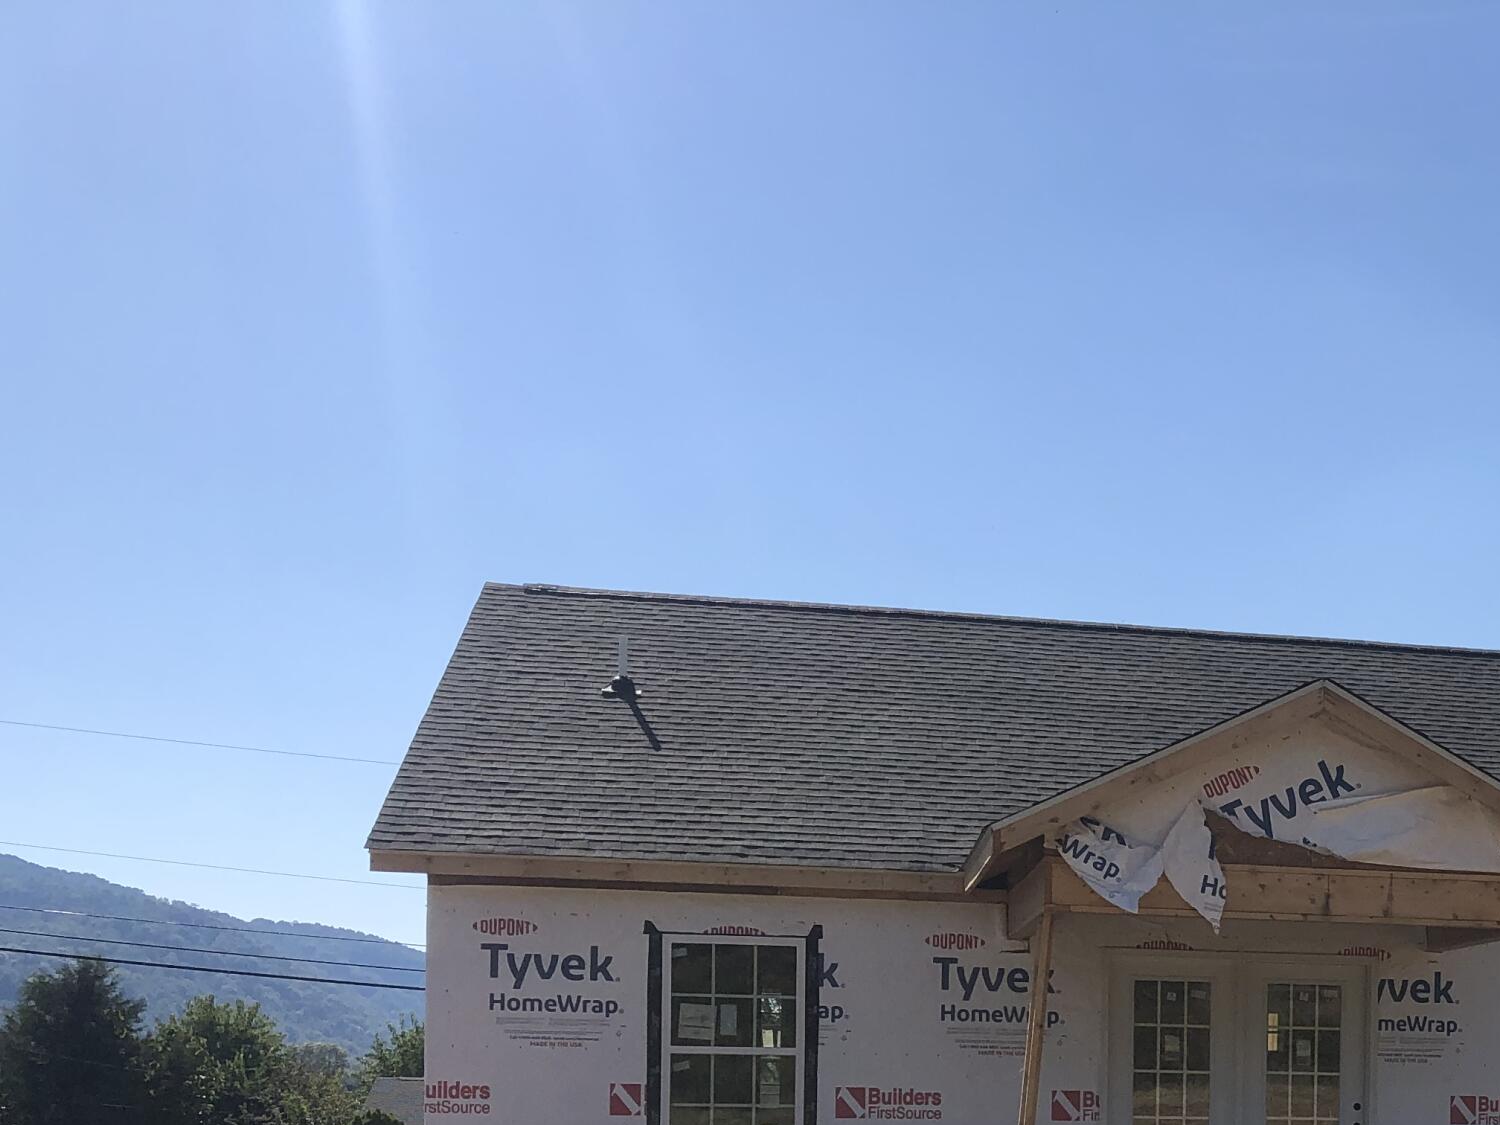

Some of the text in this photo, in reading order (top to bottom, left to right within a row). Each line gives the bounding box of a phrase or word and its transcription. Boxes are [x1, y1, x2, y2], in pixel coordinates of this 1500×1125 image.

[1203, 766, 1255, 798] DUPONT
[1062, 834, 1120, 881] Wrap
[480, 919, 531, 936] DUPONT
[932, 933, 979, 949] DUPONT
[480, 944, 615, 988] Tyvek
[1378, 971, 1454, 1004] vek
[489, 994, 618, 1017] HomeWrap
[941, 1004, 1058, 1027] HomeWp
[1378, 1016, 1457, 1036] meWrap
[426, 1081, 490, 1099] uilders
[869, 1087, 941, 1105] Builders
[425, 1100, 490, 1114] rstSource
[869, 1107, 942, 1120] FirstSource
